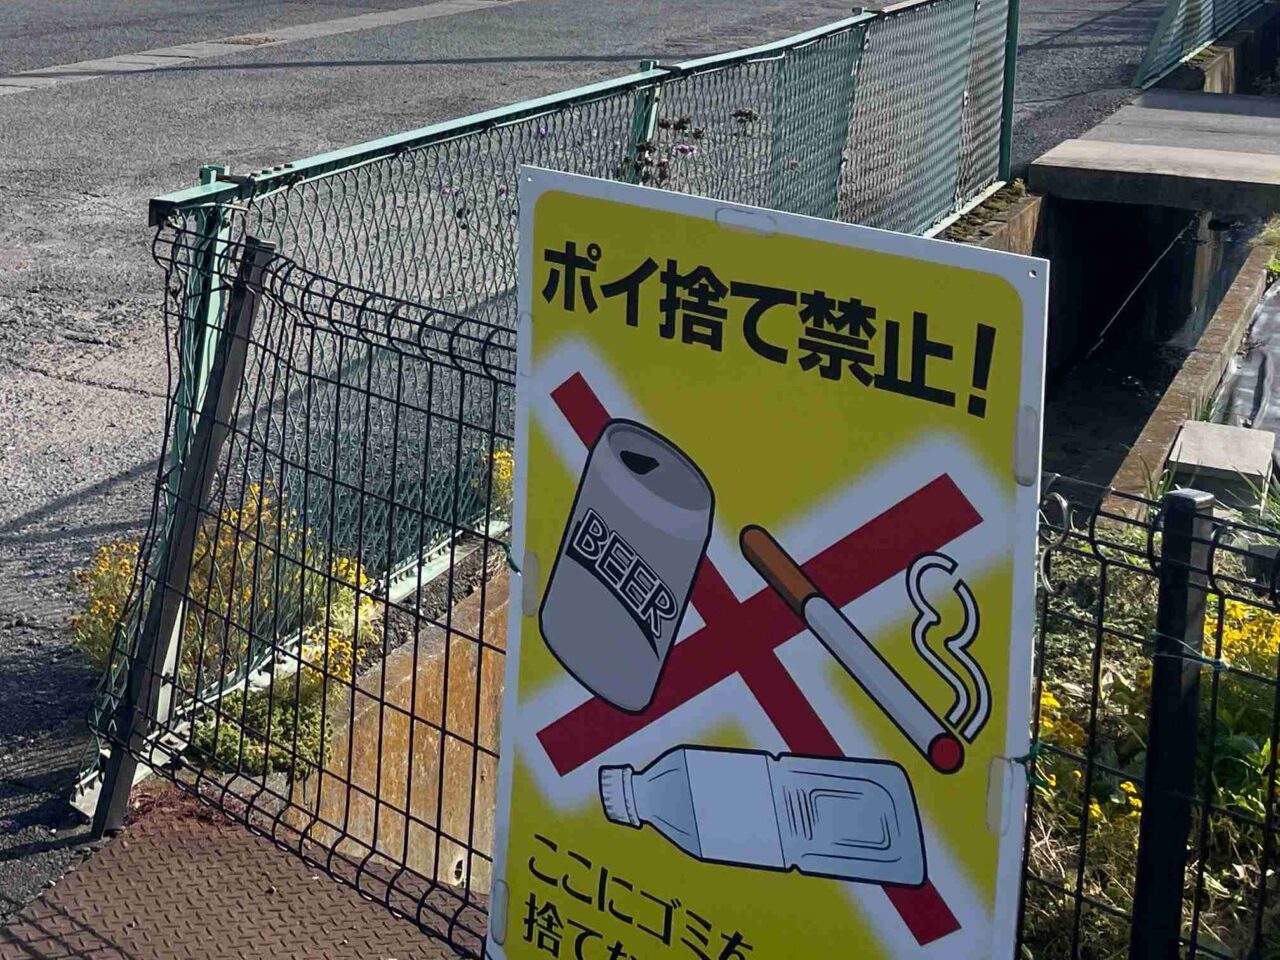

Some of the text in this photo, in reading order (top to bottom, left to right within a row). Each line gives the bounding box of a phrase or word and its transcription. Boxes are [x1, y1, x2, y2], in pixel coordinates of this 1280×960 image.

[541, 240, 997, 419] ポイ捨て禁止！
[571, 508, 678, 639] BEER
